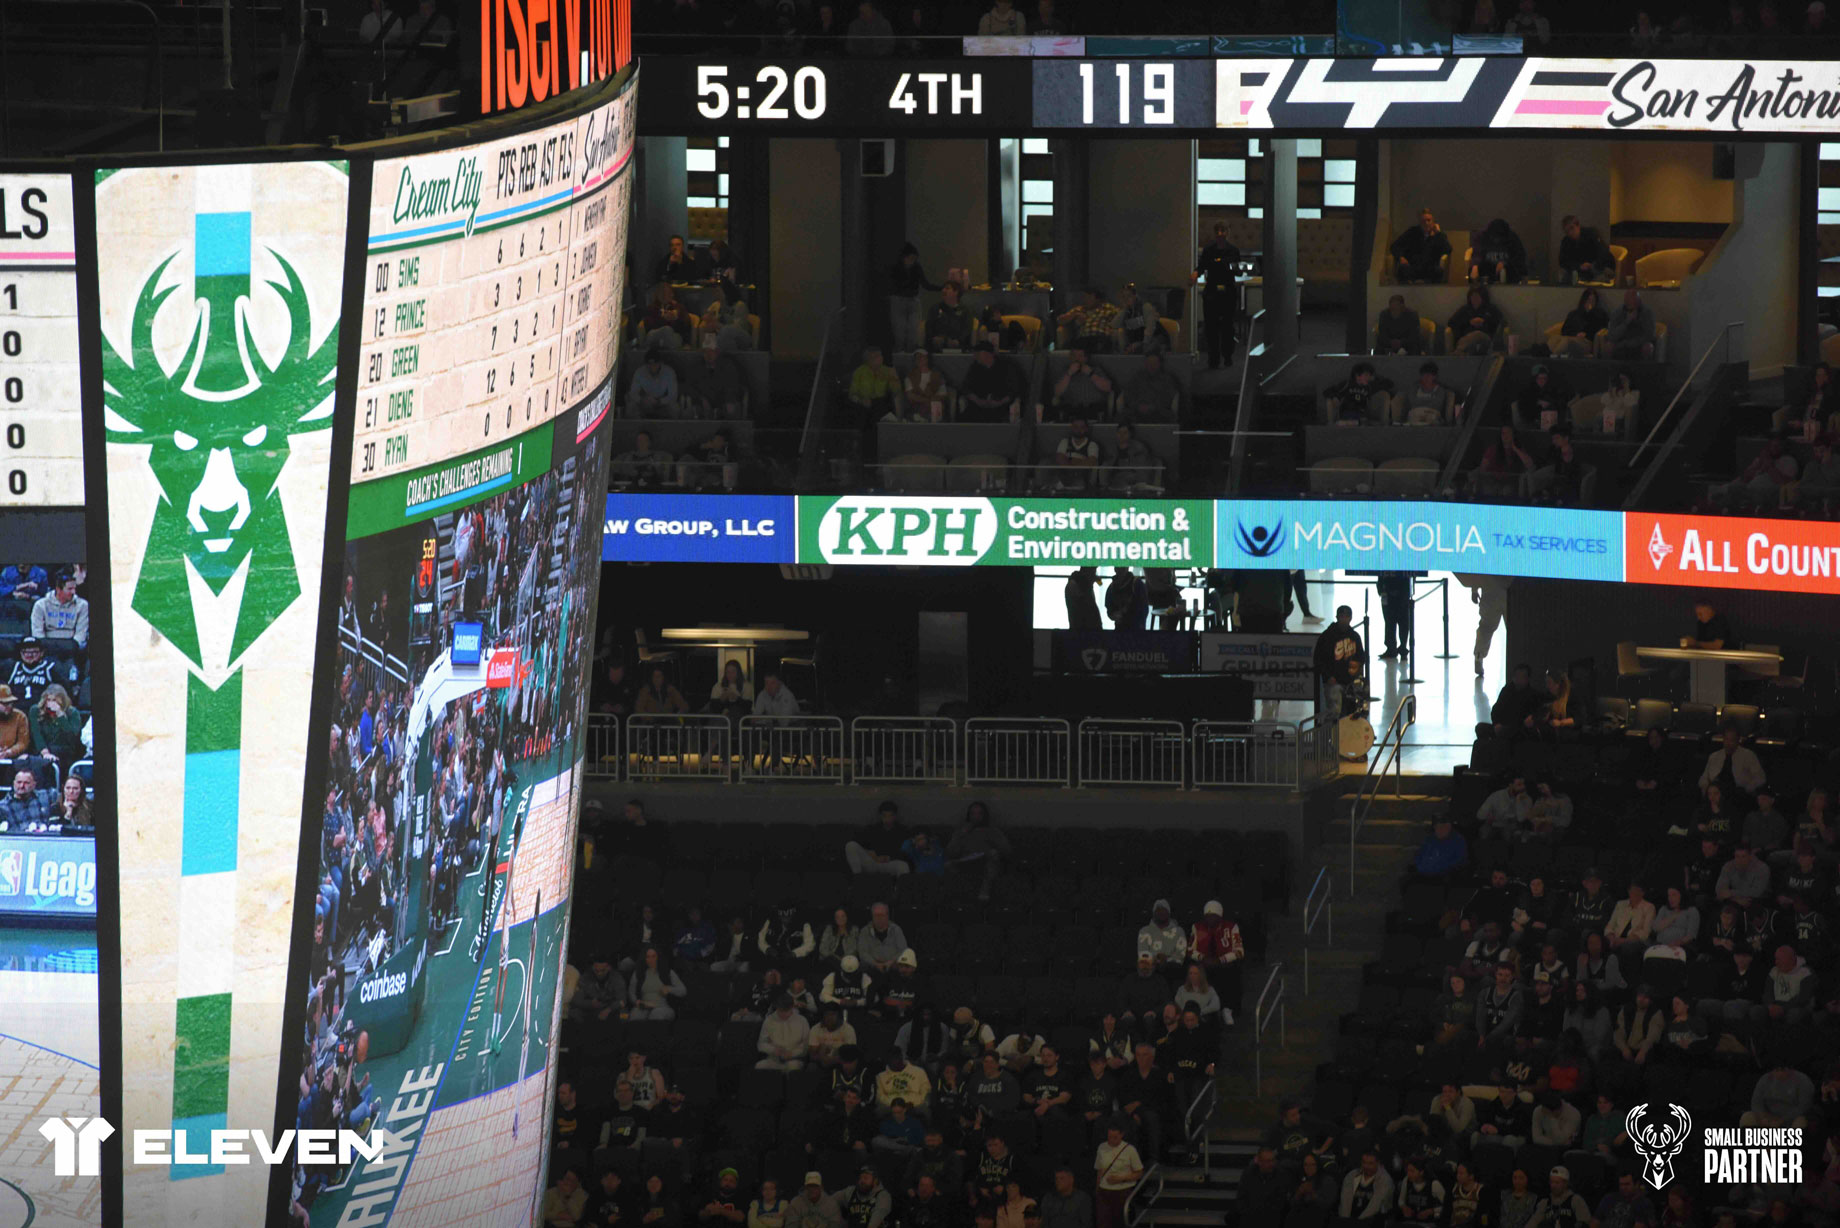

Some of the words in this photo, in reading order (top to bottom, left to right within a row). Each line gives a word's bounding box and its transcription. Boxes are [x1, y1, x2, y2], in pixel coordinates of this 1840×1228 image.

[697, 65, 826, 119] 5:20
[889, 73, 983, 115] 4TH
[1079, 63, 1175, 124] 119
[1607, 61, 1699, 128] San
[497, 148, 517, 199] PTS
[518, 143, 538, 194] REB
[539, 137, 558, 189] AST
[557, 131, 574, 182] FLS
[393, 165, 450, 224] Cream
[451, 156, 483, 232] City
[398, 256, 420, 288] SIMS
[497, 239, 503, 263] 6
[520, 233, 525, 257] 6
[539, 227, 544, 251] 2
[558, 220, 562, 243] 1
[3, 284, 18, 309] 1
[375, 307, 386, 338] 12
[395, 299, 426, 333] PRINCE
[494, 284, 500, 307] 3
[516, 277, 522, 300] 3
[537, 270, 541, 293] 1
[554, 263, 559, 287] 3
[3, 331, 21, 356] 0
[369, 353, 382, 383] 20
[391, 344, 420, 378] GREEN
[492, 326, 497, 350] 7
[513, 320, 519, 343] 3
[533, 312, 538, 336] 2
[5, 377, 23, 402] 0
[366, 398, 377, 428] 21
[388, 389, 414, 422] DIENG
[486, 369, 496, 394] 12
[510, 362, 515, 386] 6
[530, 354, 535, 378] 5
[7, 424, 25, 449] 0
[362, 442, 375, 473] 30
[385, 434, 408, 466] RYAN
[485, 412, 490, 437] 0
[507, 405, 512, 429] 0
[527, 398, 531, 421] 0
[9, 470, 27, 495] 0
[407, 473, 438, 507] COACH'S
[439, 459, 481, 497] CHALLENGES
[726, 519, 775, 536] LLC
[832, 506, 982, 556] KPH
[1007, 505, 1165, 531] Construction
[1172, 507, 1190, 531] &
[1008, 535, 1192, 561] Environmental
[1294, 521, 1486, 554] MAGNOLIA
[1491, 533, 1525, 549] TAX
[1529, 535, 1608, 554] SERVICES
[25, 851, 96, 906] Leag
[360, 970, 406, 1003] coinbase
